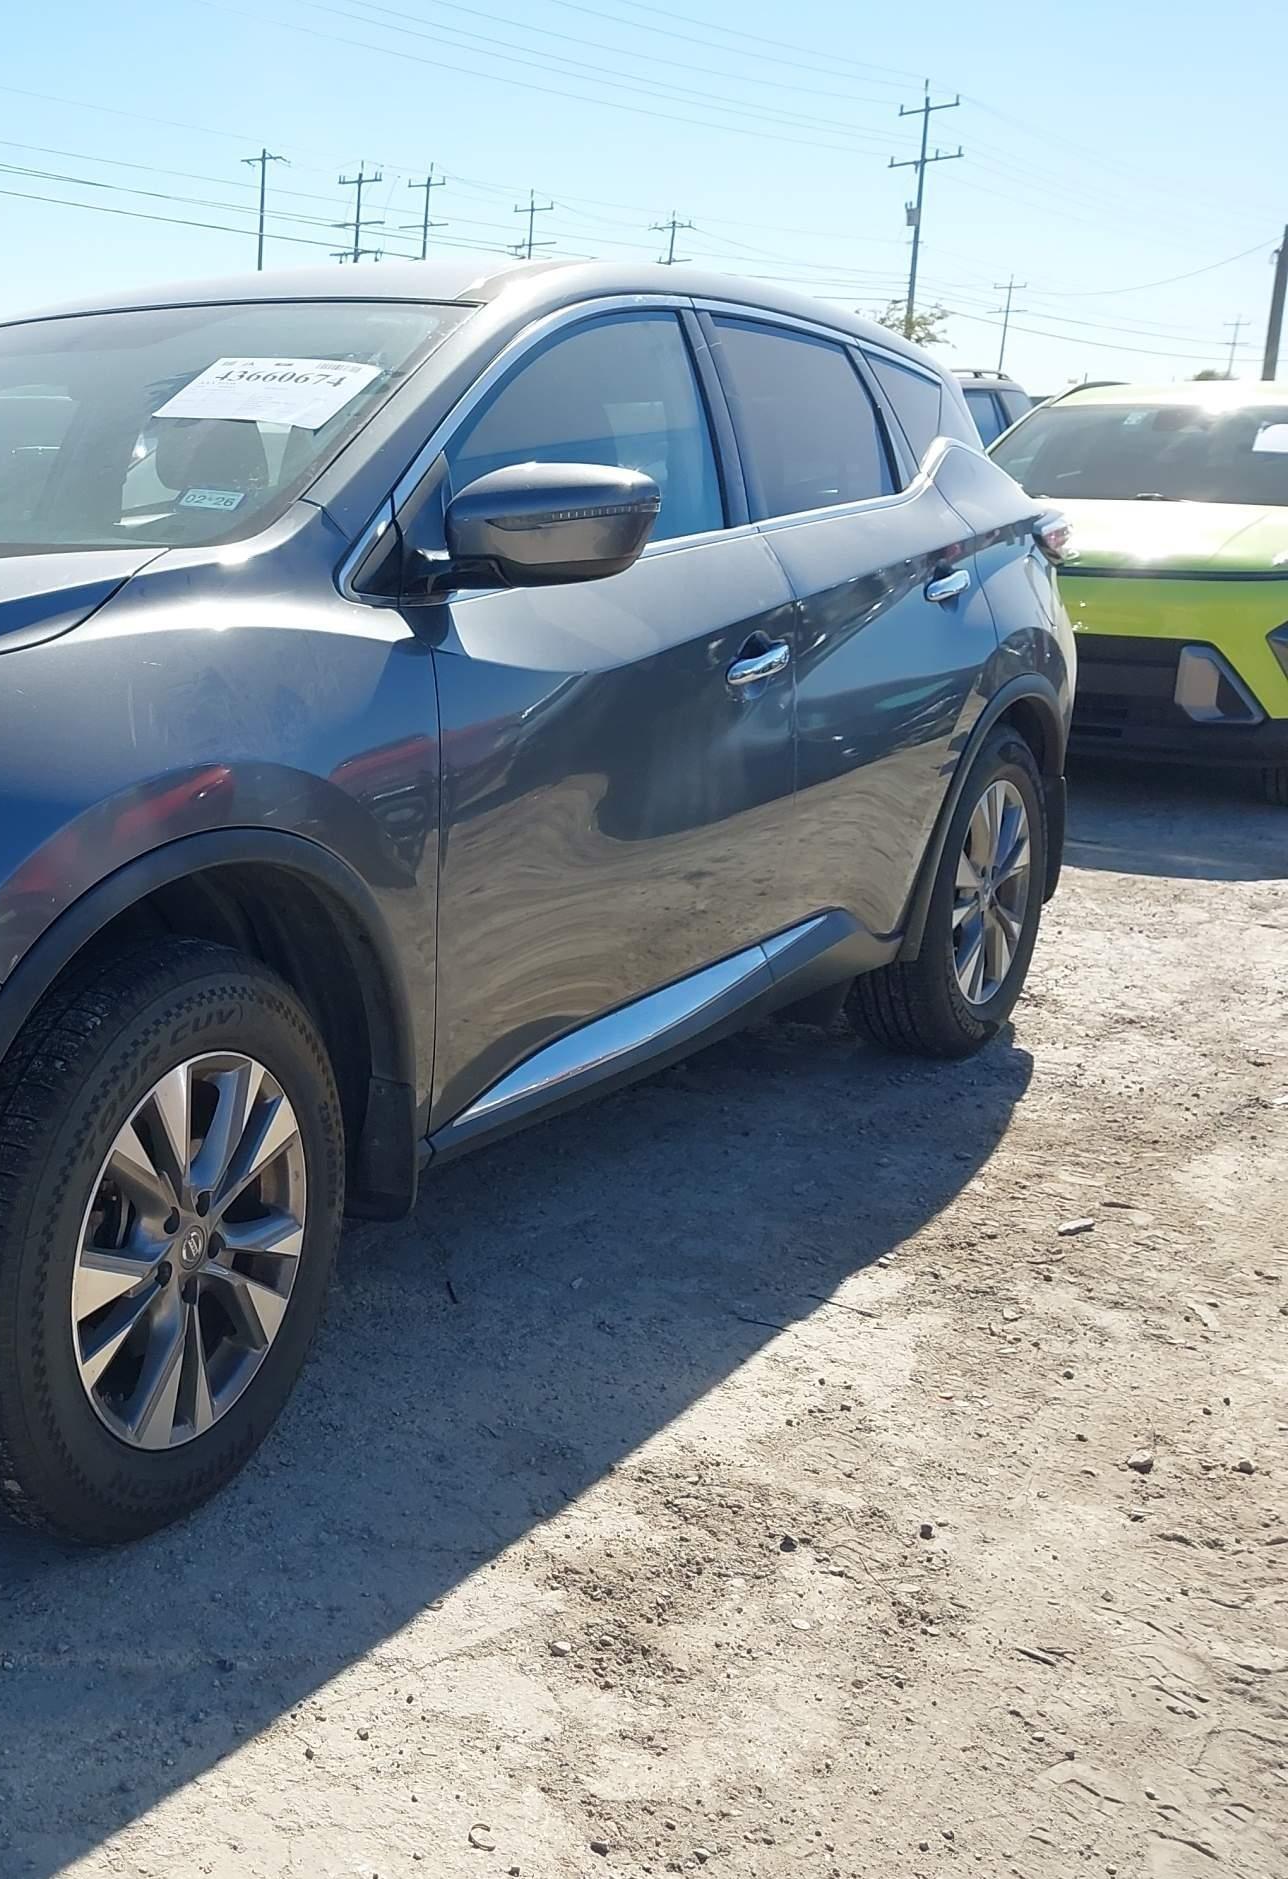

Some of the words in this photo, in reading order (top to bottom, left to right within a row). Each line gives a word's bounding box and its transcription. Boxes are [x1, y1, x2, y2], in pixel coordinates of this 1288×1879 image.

[216, 370, 348, 388] 43660674
[184, 494, 207, 504] 02
[212, 496, 235, 507] 26
